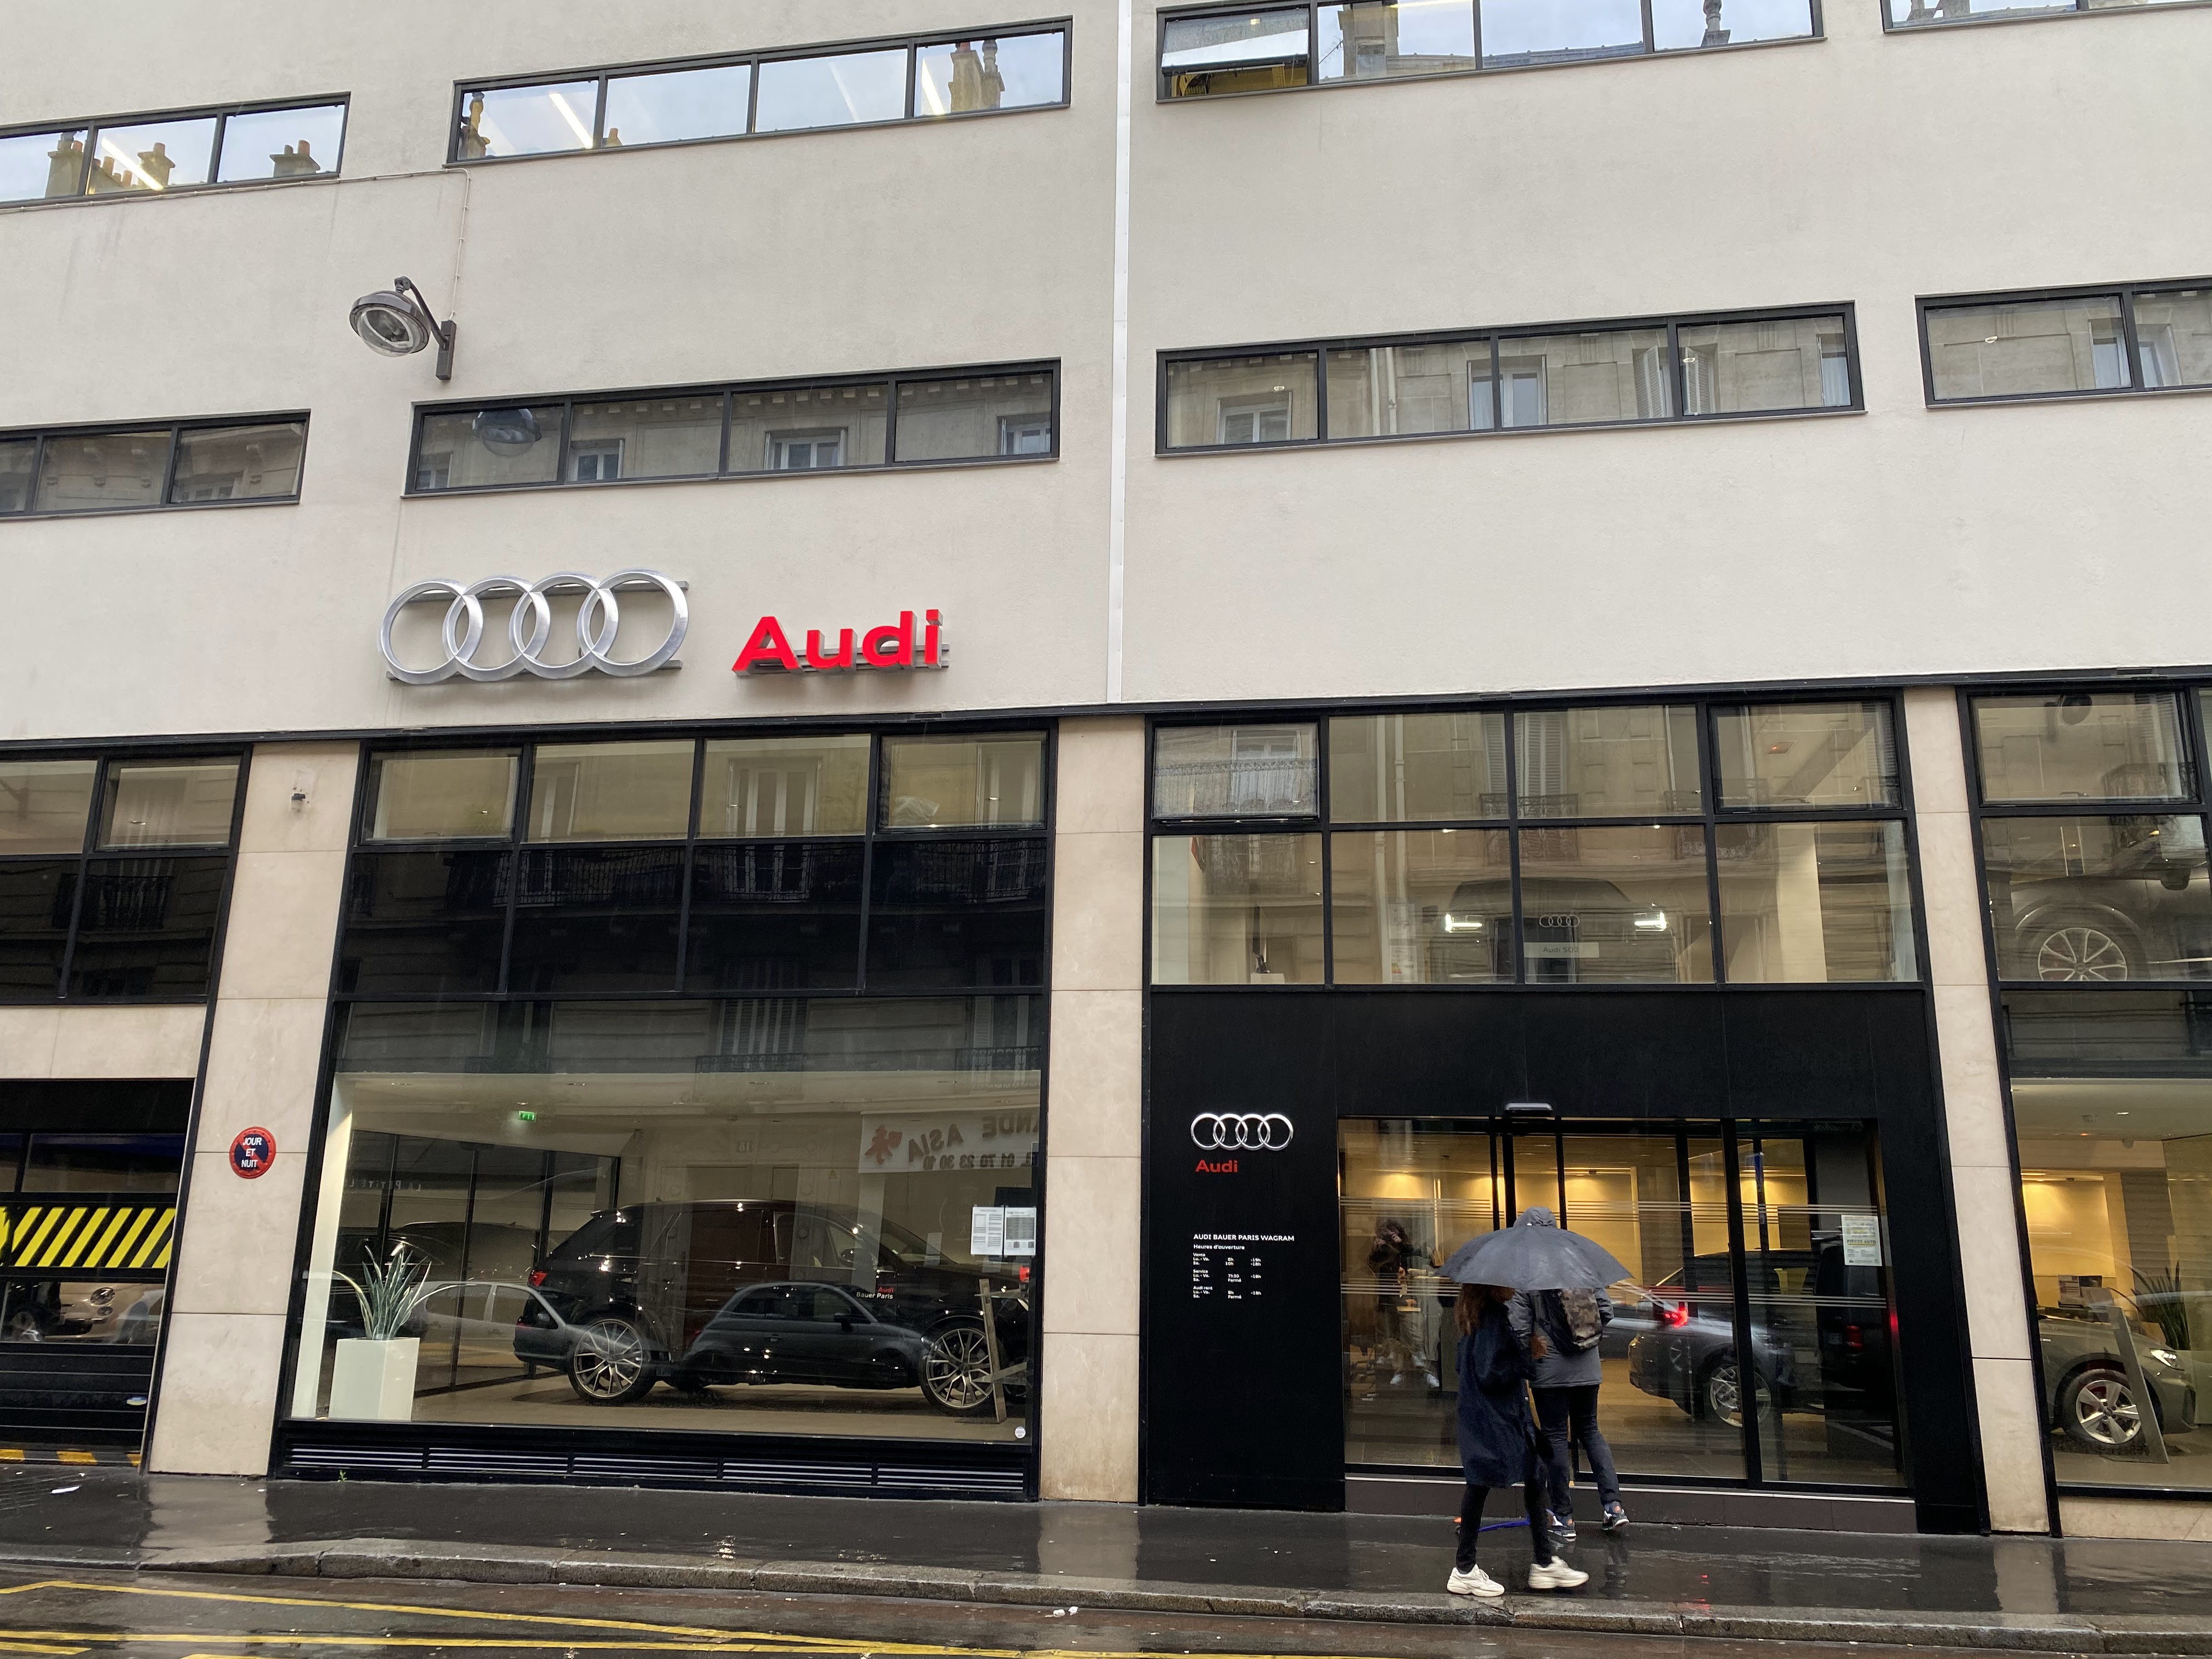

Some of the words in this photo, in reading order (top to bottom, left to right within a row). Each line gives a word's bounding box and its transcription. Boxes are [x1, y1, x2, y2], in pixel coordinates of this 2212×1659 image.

[732, 609, 943, 675] Audi
[242, 1137, 262, 1146] JOUR
[245, 1148, 256, 1157] ET
[241, 1159, 258, 1168] NUIT
[1195, 1159, 1238, 1173] Audi
